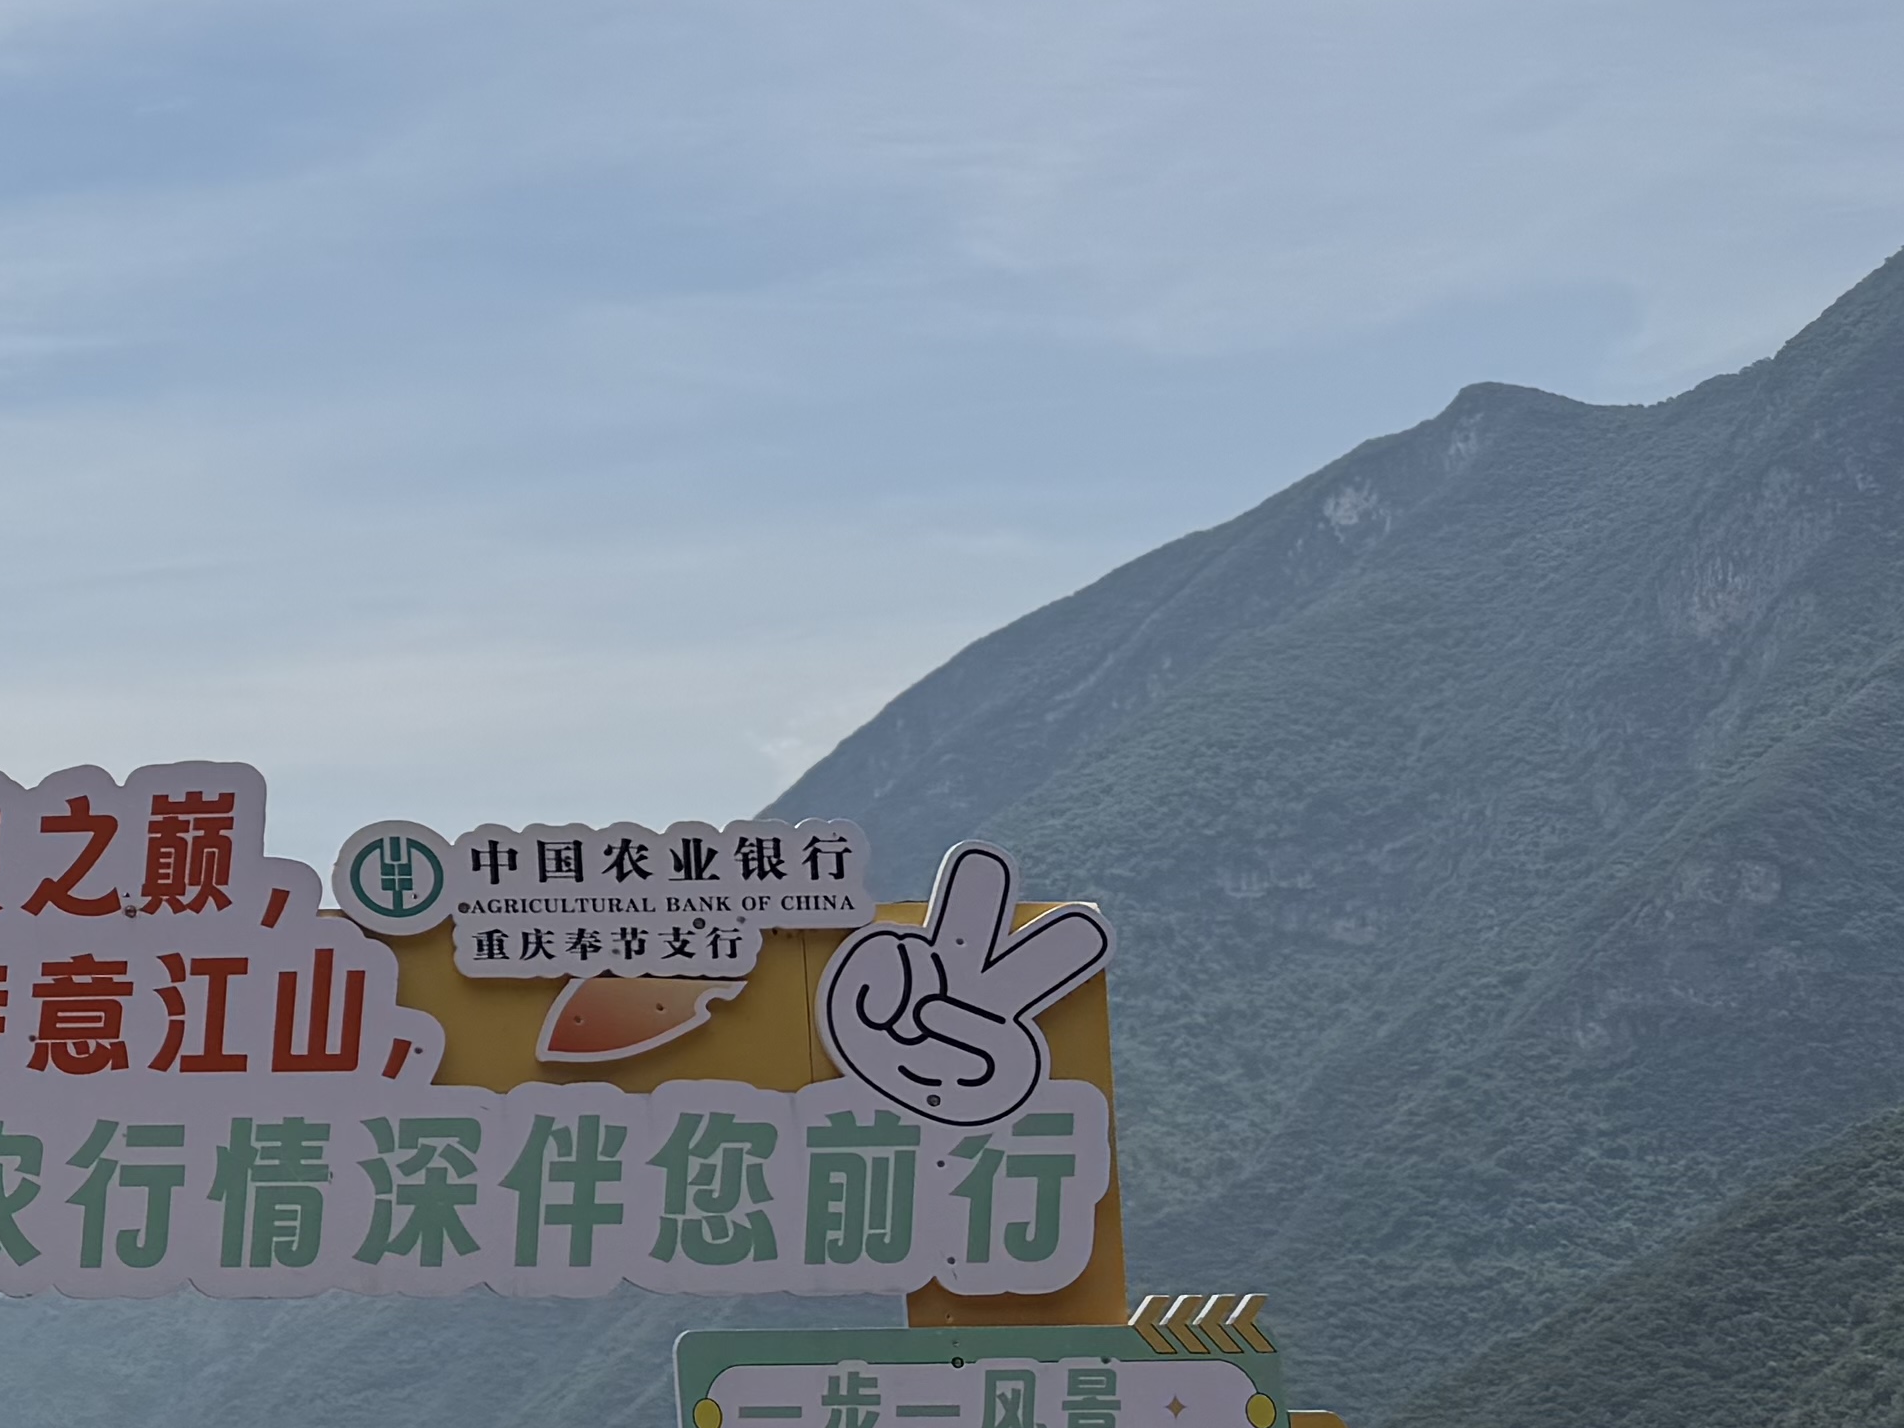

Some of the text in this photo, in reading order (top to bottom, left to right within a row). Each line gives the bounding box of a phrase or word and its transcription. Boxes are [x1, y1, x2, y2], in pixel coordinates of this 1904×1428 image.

[470, 835, 853, 886] 中国农业银行
[470, 894, 856, 914] AGRICULTURAL BANK OF CHINA
[471, 926, 743, 961] 重庆奉节支行
